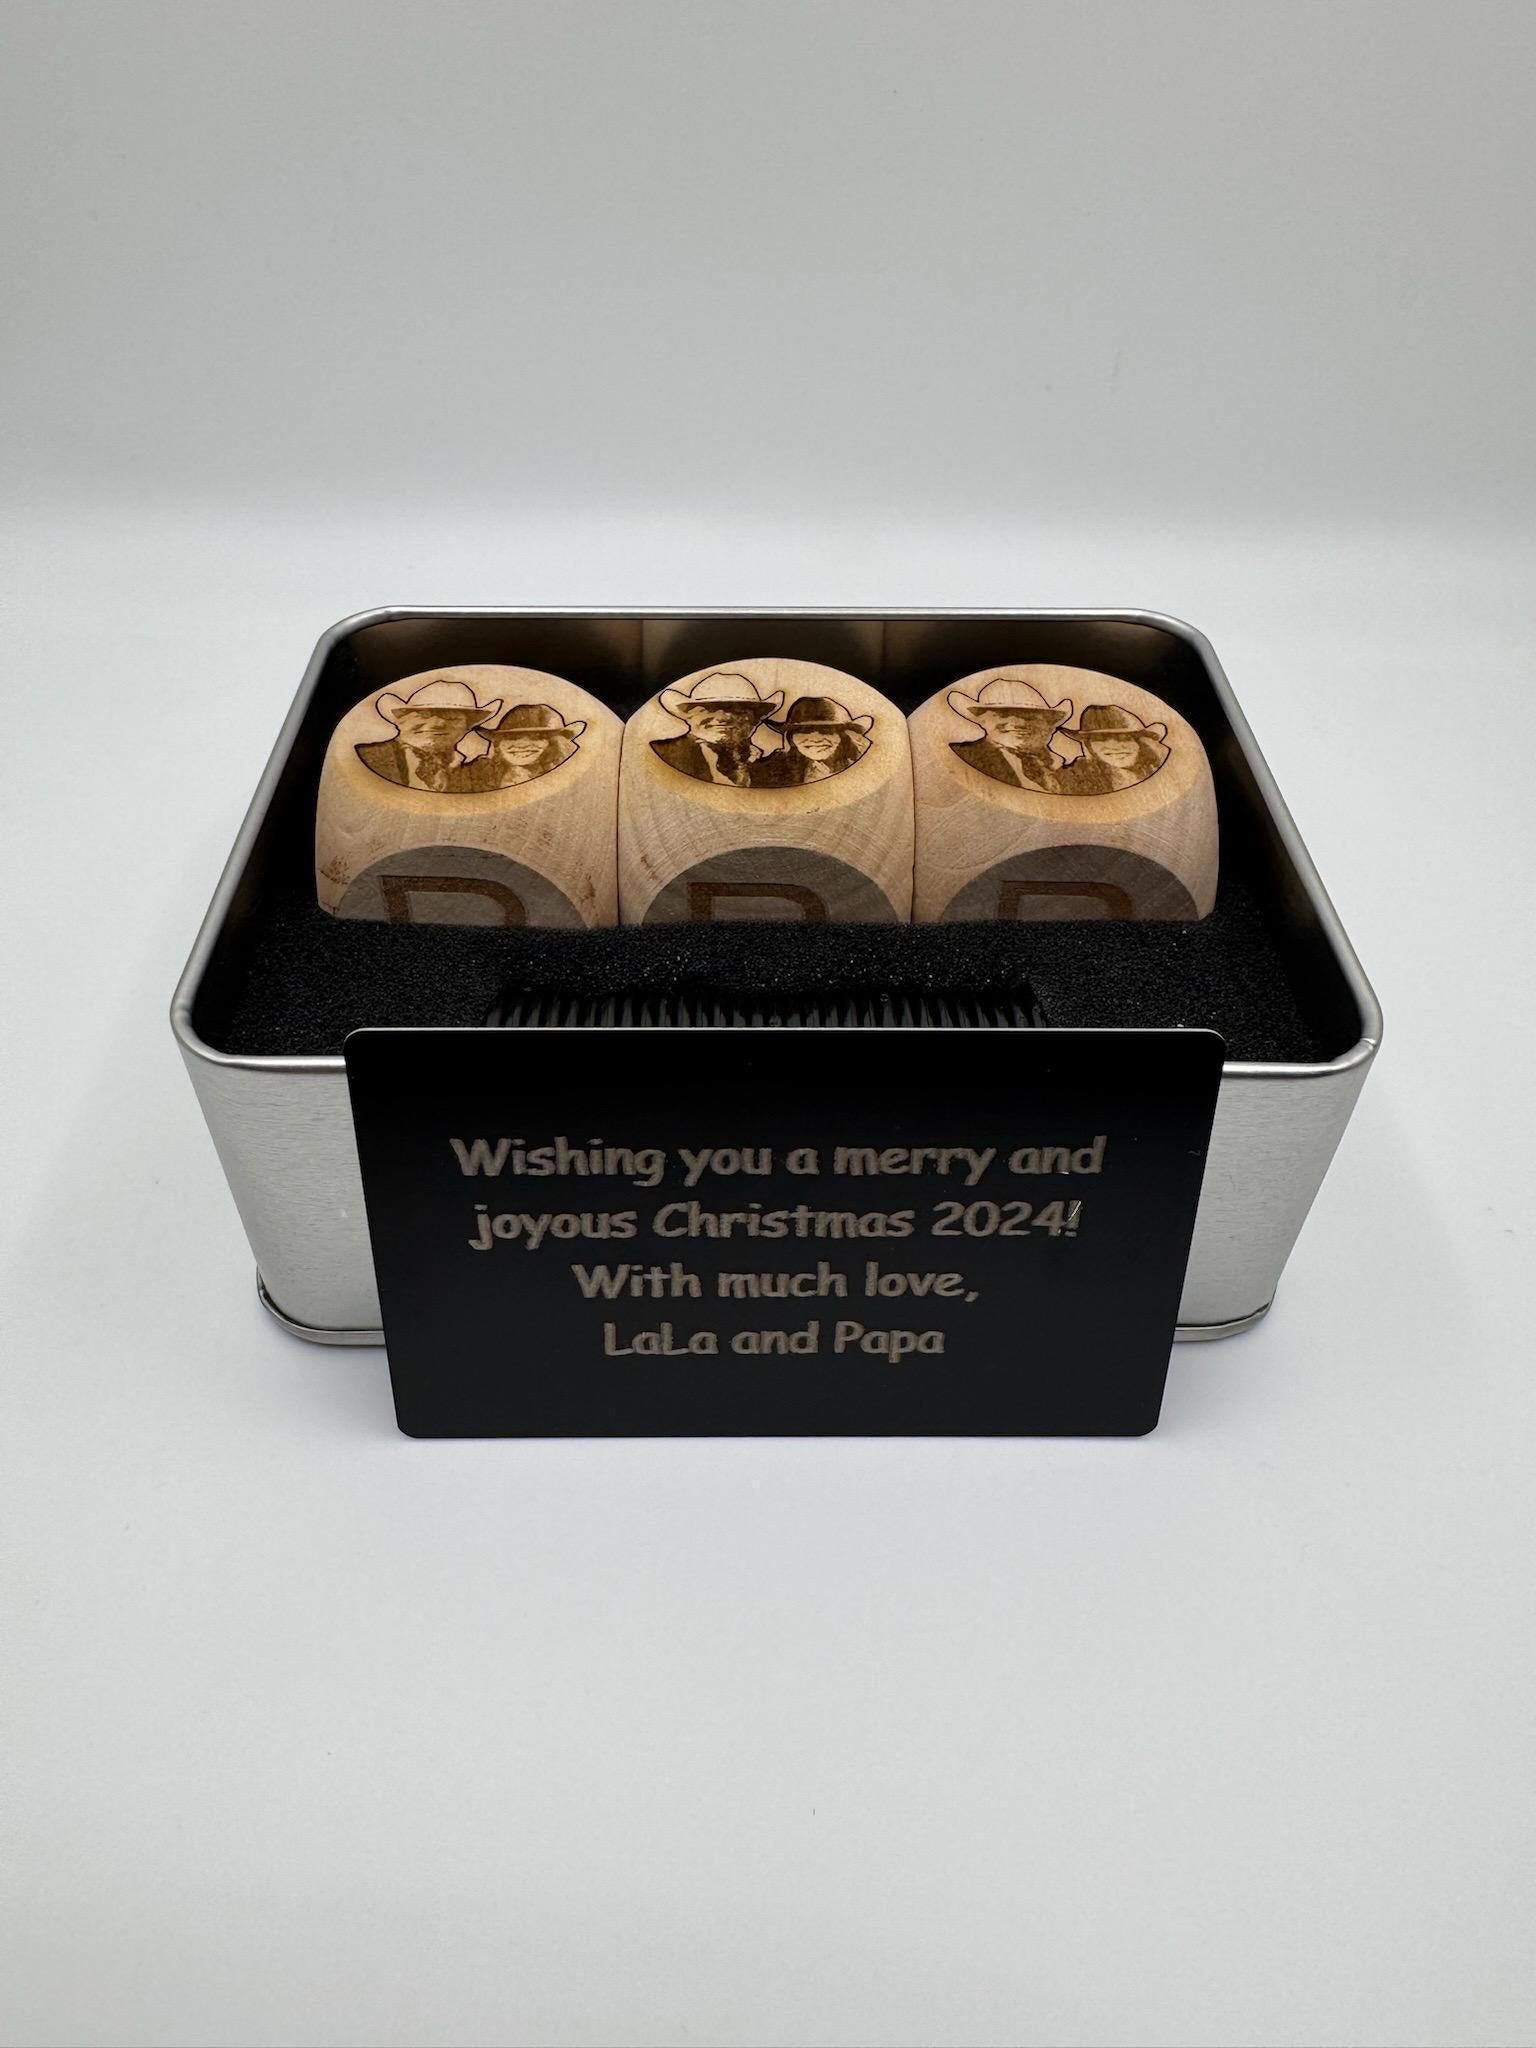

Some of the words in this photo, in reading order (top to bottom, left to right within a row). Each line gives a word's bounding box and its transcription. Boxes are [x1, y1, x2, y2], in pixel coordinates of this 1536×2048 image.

[449, 1136, 666, 1187] Wishing
[679, 1147, 772, 1187] you
[786, 1147, 819, 1176] a
[833, 1146, 997, 1187] merry
[1007, 1135, 1107, 1176] and
[467, 1203, 638, 1251] joyous
[652, 1200, 915, 1239] Christmas
[931, 1200, 1083, 1238] 2024!
[570, 1262, 703, 1299] With
[717, 1261, 848, 1299] much
[864, 1261, 980, 1302] love,
[603, 1322, 719, 1356] LaLa
[730, 1320, 820, 1355] and
[833, 1320, 946, 1364] Papa
